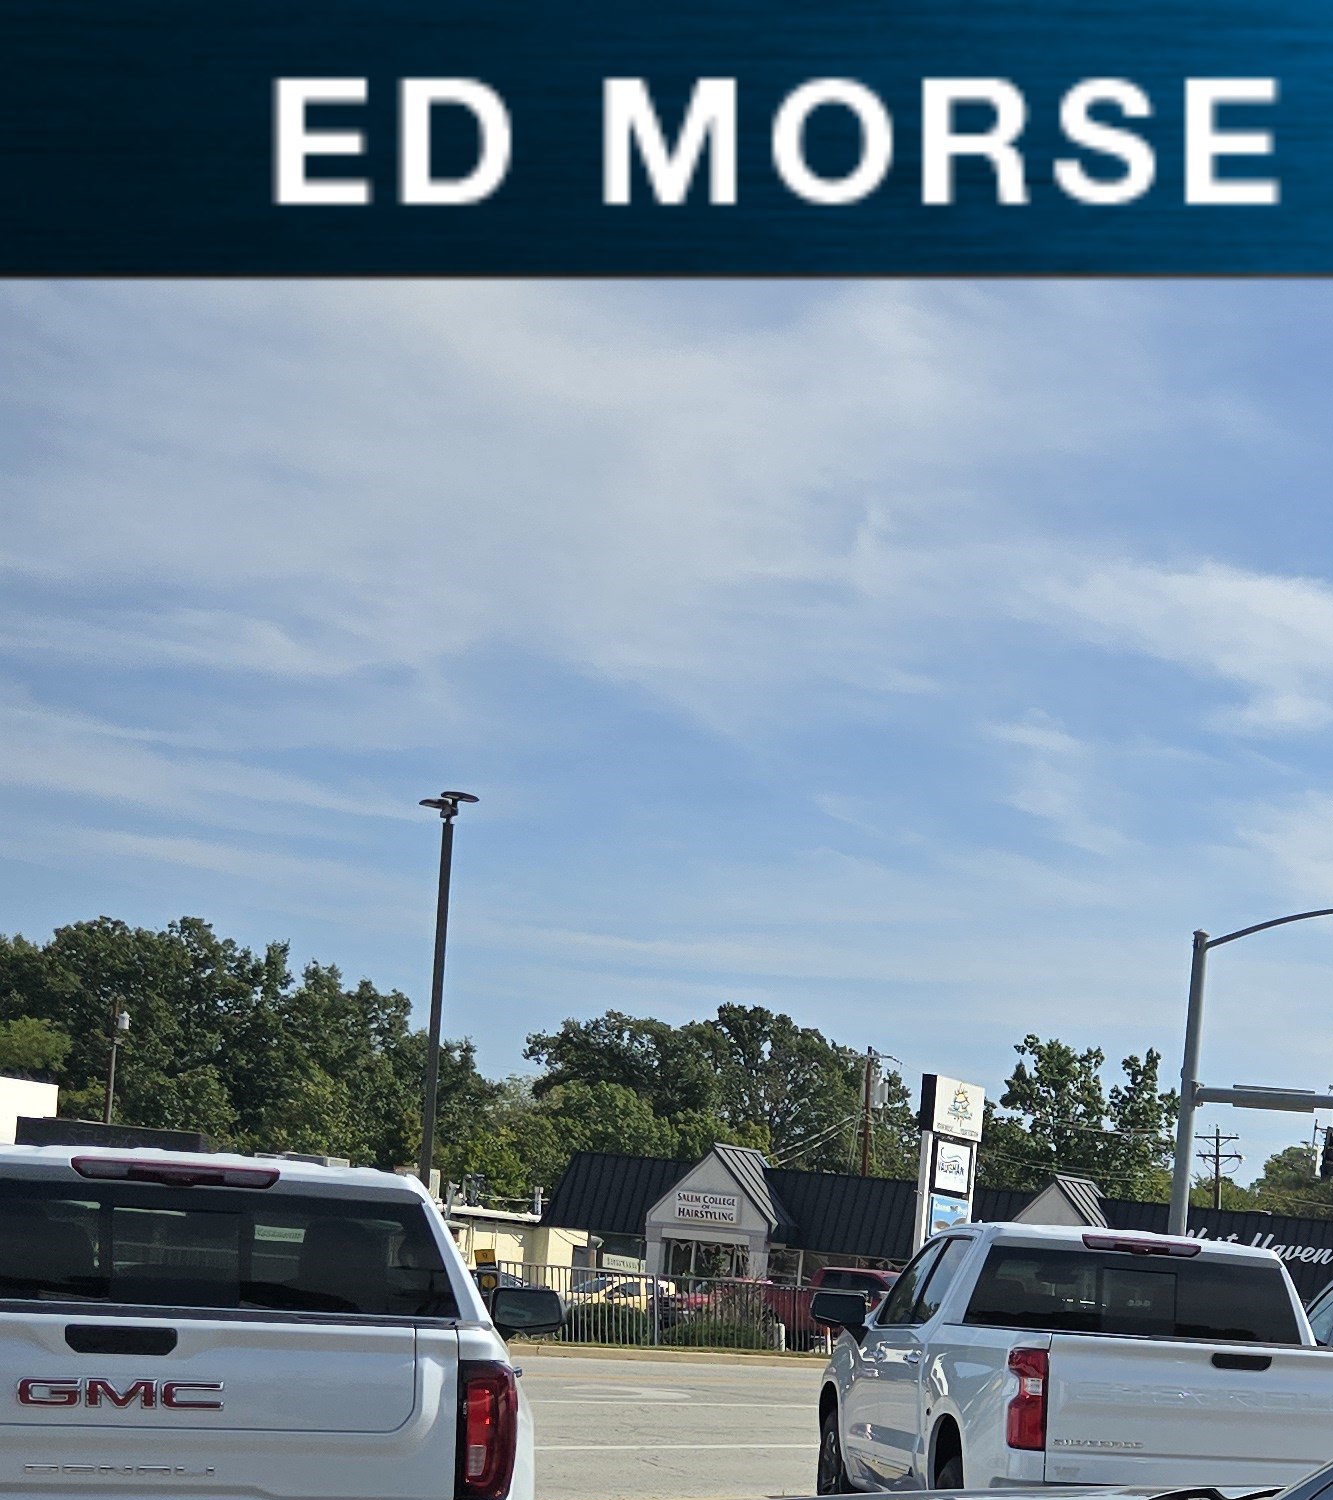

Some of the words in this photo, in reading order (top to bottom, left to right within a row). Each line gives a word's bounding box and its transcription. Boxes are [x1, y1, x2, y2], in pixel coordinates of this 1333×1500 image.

[677, 1192, 701, 1204] SALEM
[702, 1195, 736, 1207] COLLEGE
[677, 1207, 734, 1222] HAIRSTYLING
[16, 1376, 225, 1411] GMC
[23, 1462, 216, 1477] DENALI
